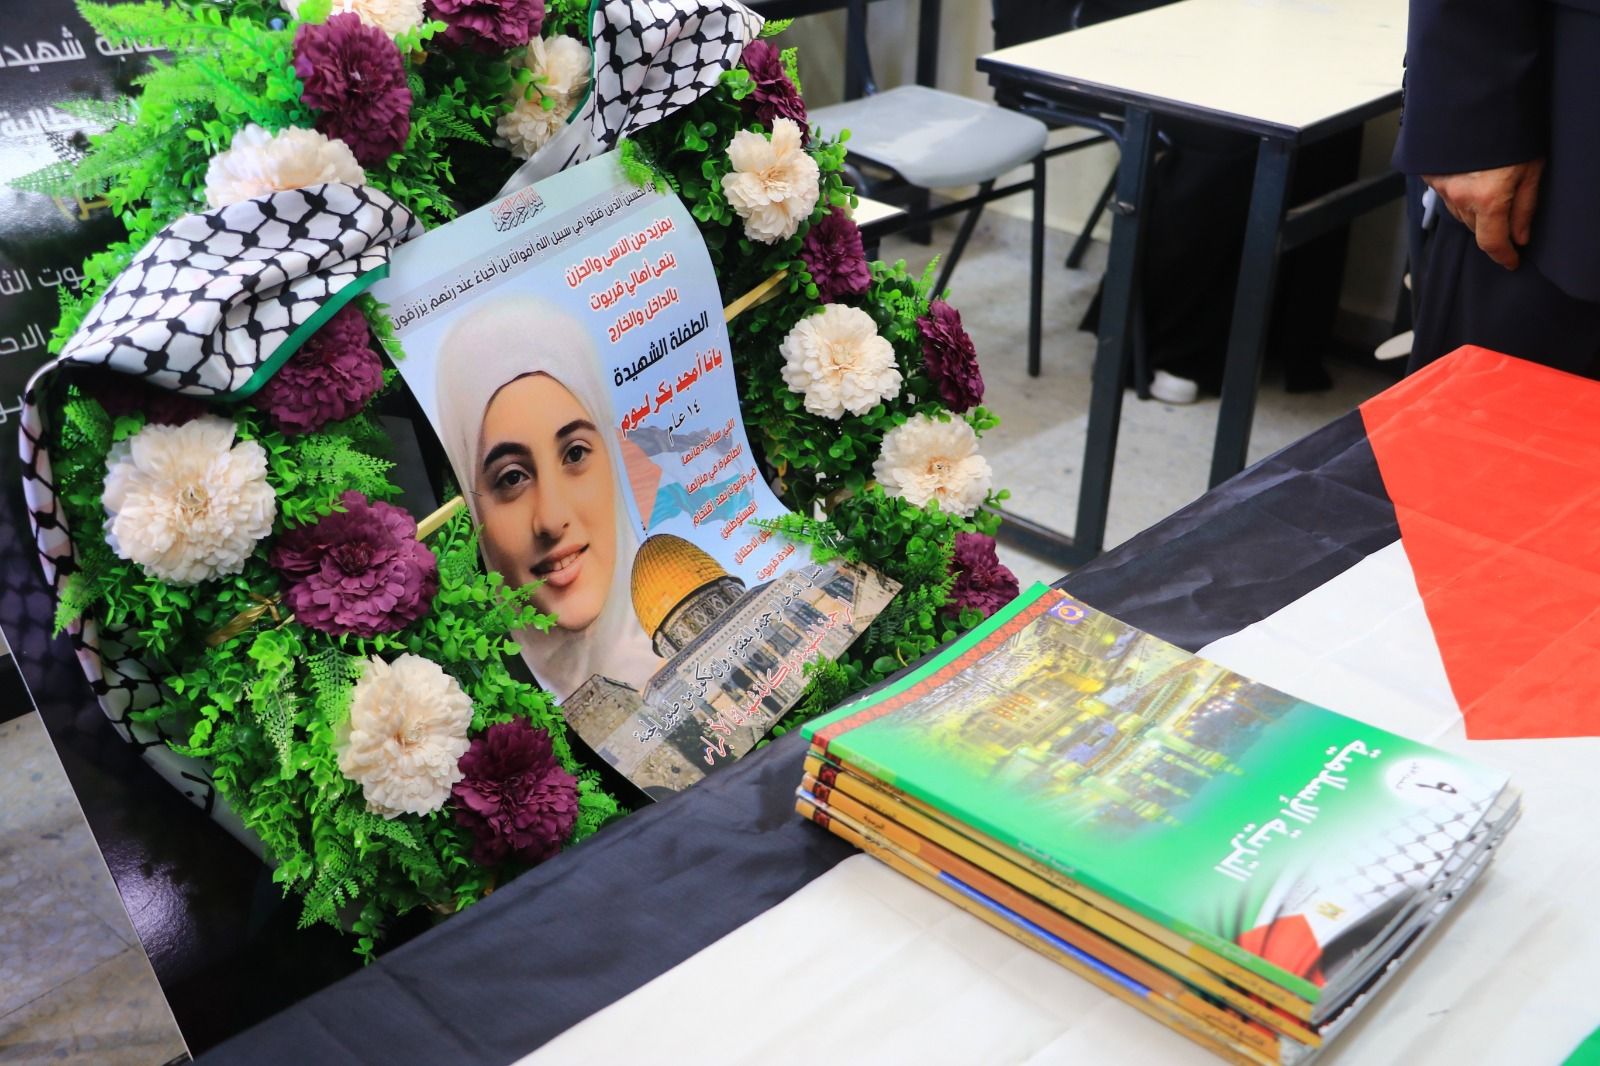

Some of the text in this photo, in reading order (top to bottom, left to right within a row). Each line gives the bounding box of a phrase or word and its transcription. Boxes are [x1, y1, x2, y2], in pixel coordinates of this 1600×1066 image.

[631, 231, 647, 251] من
[648, 217, 675, 241] بمزيد
[566, 255, 603, 288] والحزن
[590, 252, 677, 310] ينعى أهالي قريوت
[608, 288, 679, 342] بالداخل والخارج
[614, 310, 709, 387] الطفلة الشهيدة
[653, 381, 674, 414] بكر
[1214, 739, 1382, 882] التربية الإسلامية
